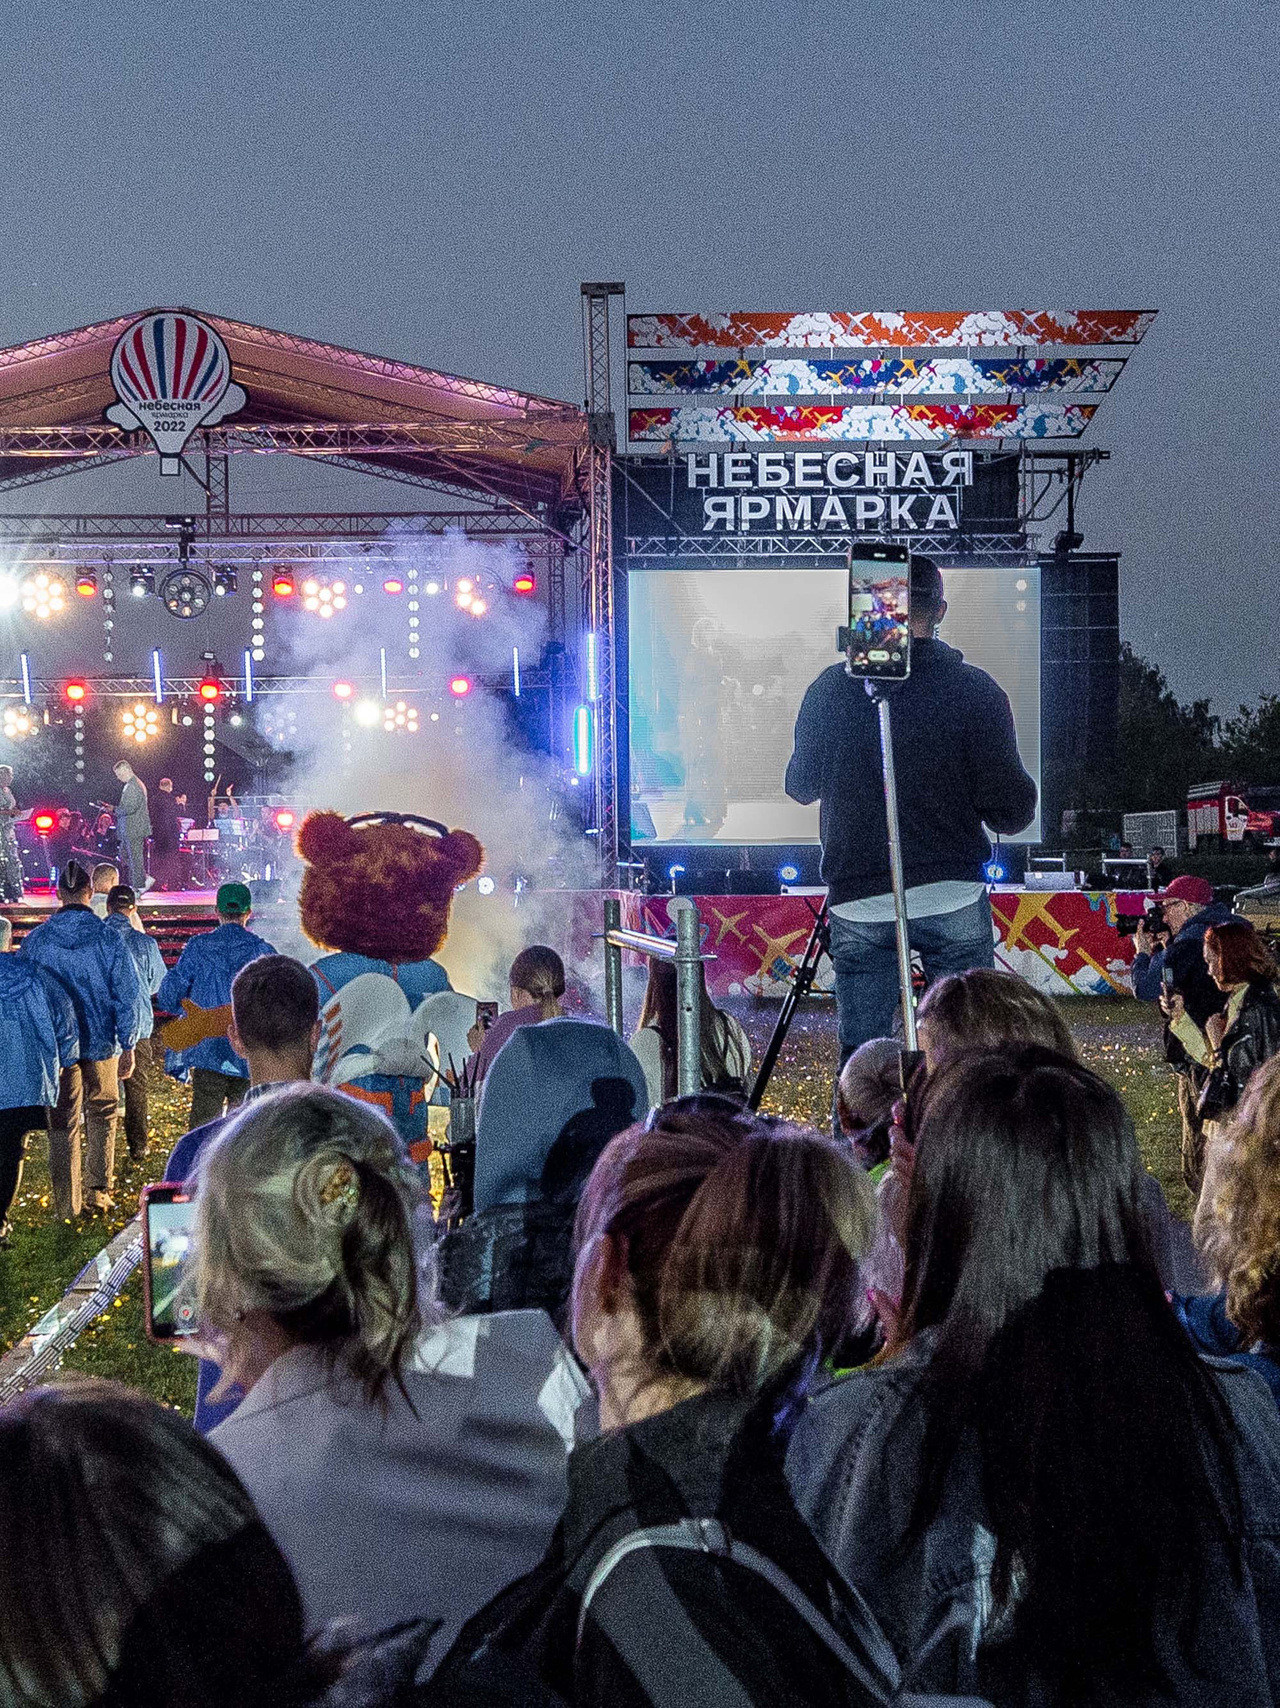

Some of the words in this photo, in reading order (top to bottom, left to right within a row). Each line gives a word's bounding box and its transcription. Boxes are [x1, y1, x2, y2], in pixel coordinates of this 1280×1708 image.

[153, 420, 186, 432] 2022
[687, 451, 974, 488] НЕБЕСНАЯ
[702, 494, 960, 532] ЯРМАРКА
